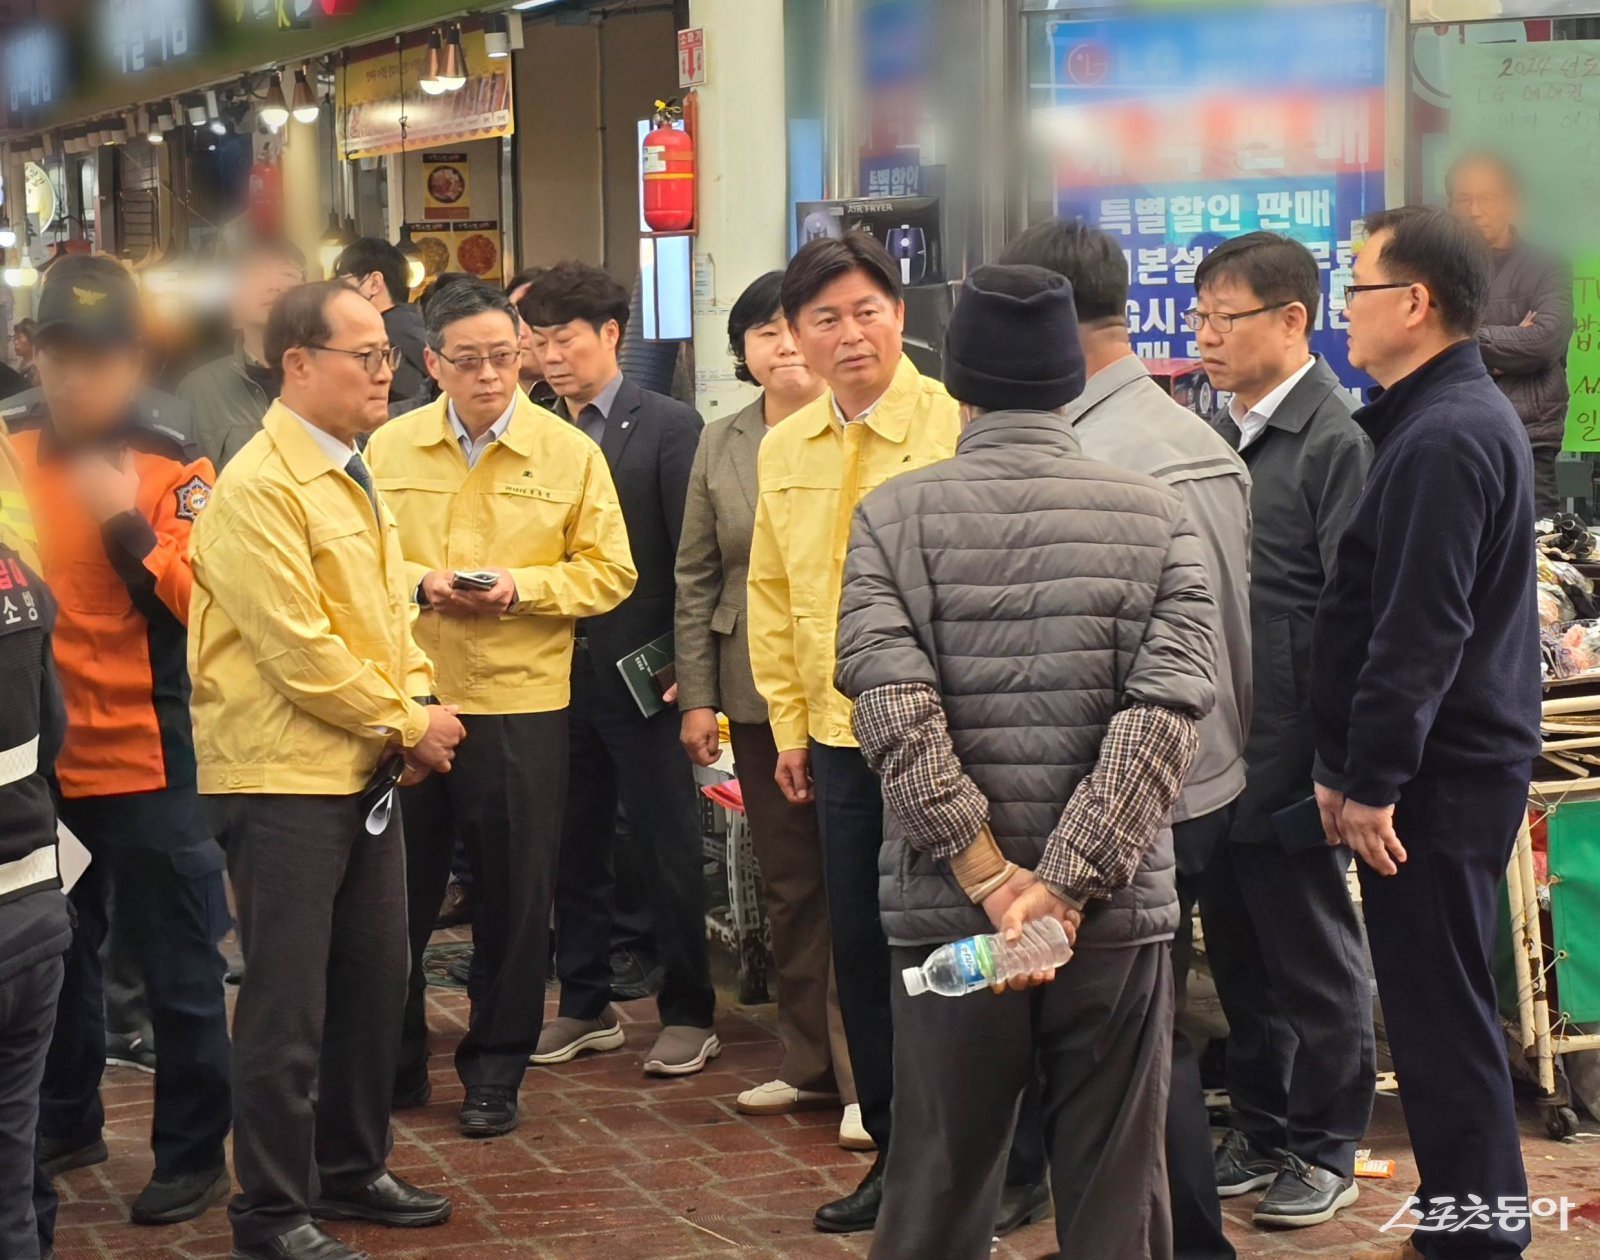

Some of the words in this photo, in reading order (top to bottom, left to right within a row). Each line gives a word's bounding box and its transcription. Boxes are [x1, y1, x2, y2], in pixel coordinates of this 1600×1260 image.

[864, 203, 893, 212] FRYER
[1099, 193, 1241, 235] 특별할인
[1256, 189, 1331, 230] 판매
